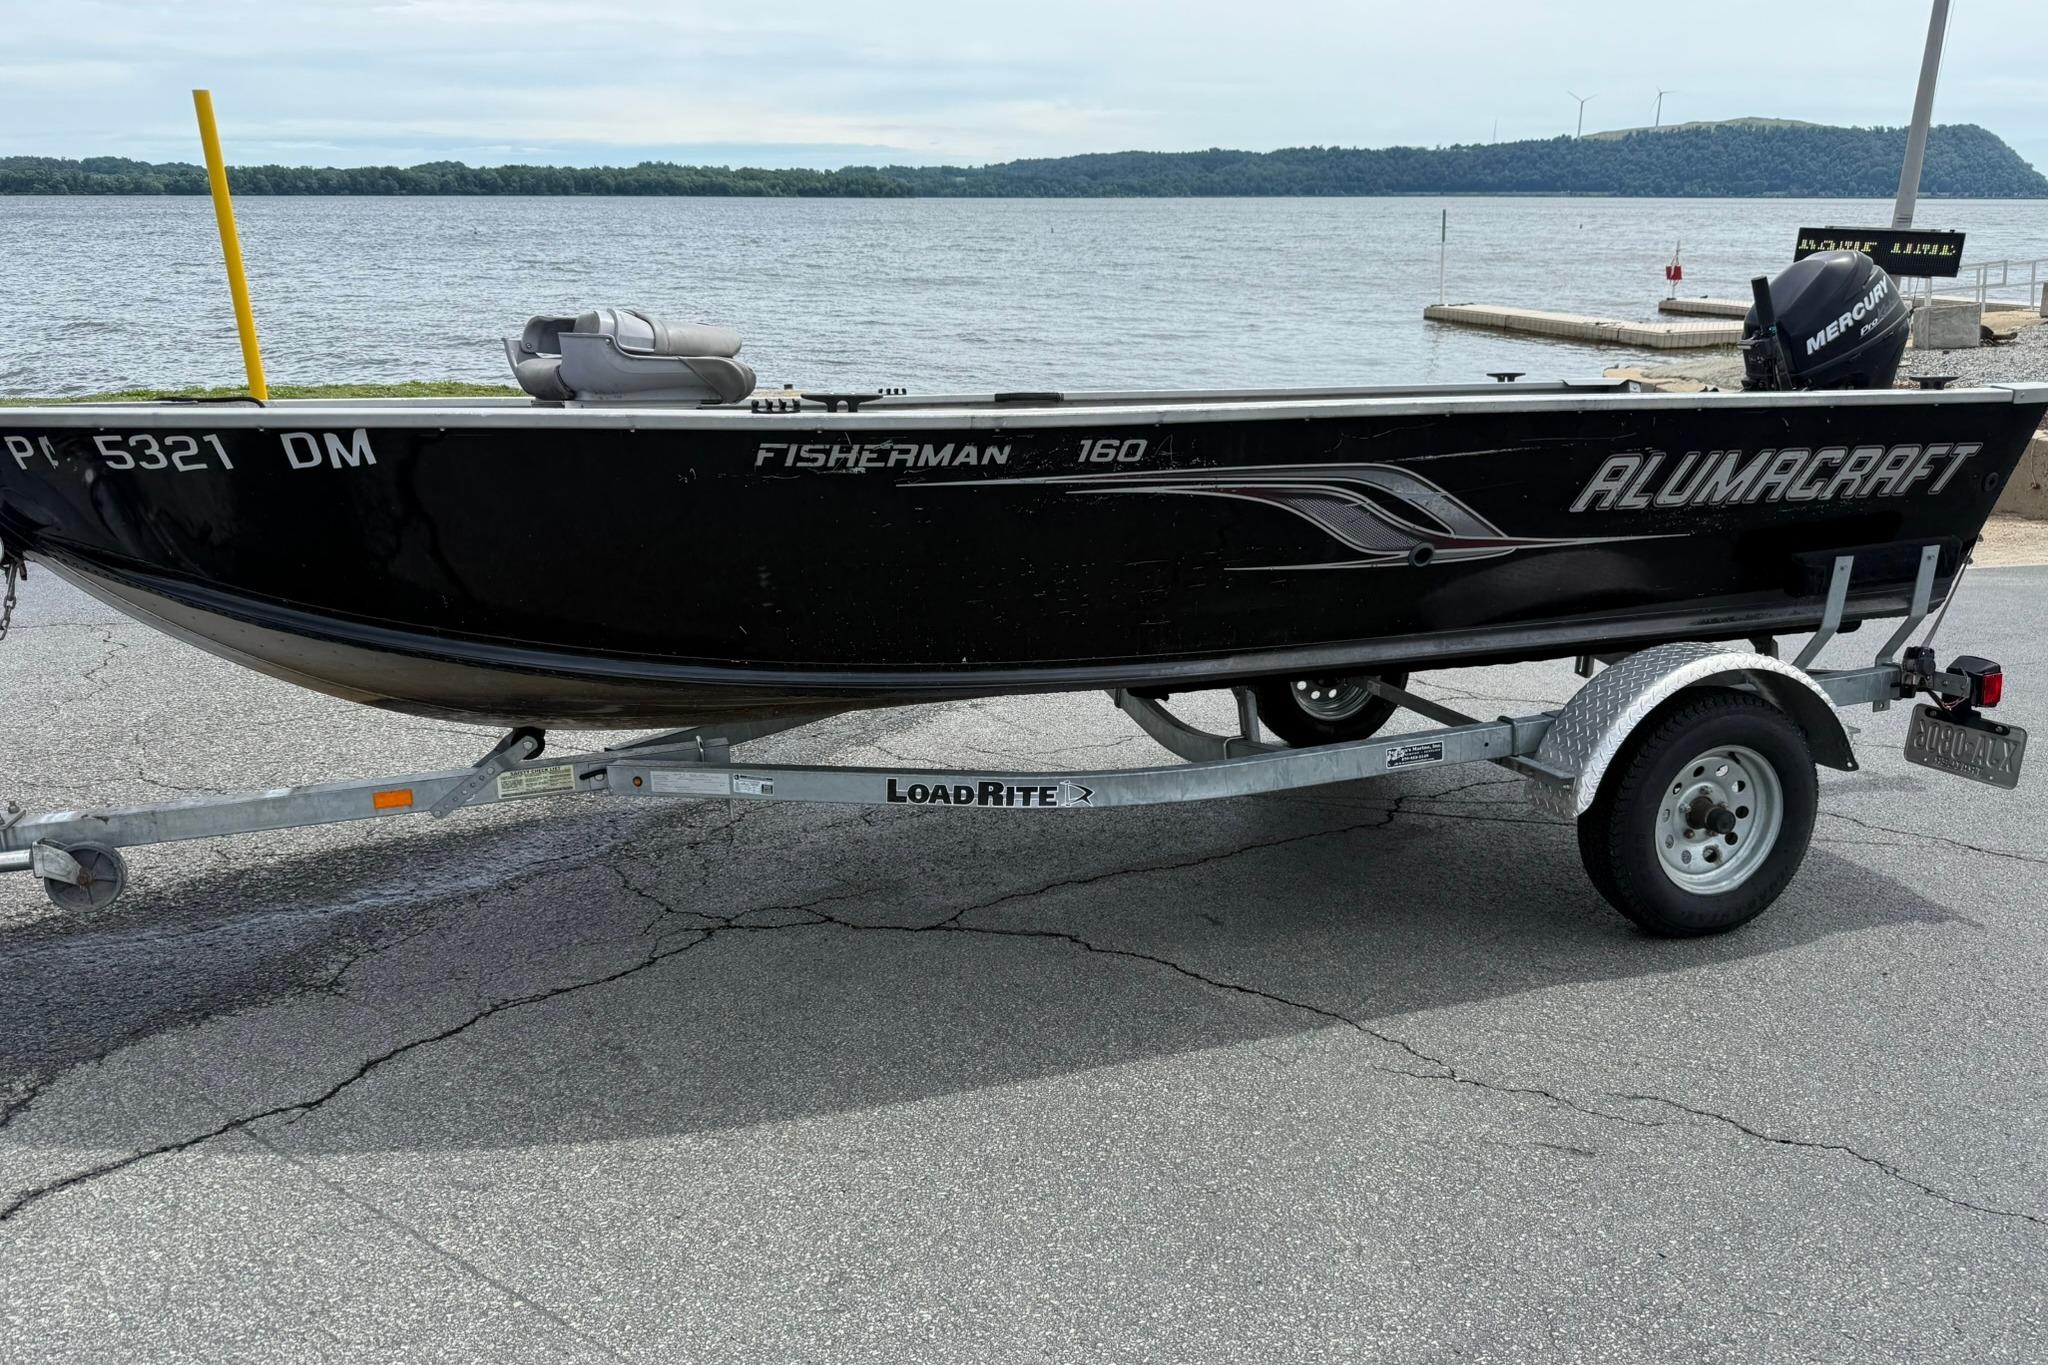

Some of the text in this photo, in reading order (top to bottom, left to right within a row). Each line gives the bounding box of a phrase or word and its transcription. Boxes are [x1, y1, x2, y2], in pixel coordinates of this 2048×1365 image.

[1805, 275, 1890, 356] MERCURY
[1859, 317, 1880, 338] Pro
[92, 433, 235, 472] 5321
[279, 428, 378, 470] DM
[754, 439, 1149, 469] FISHERMAN 160
[1568, 441, 1984, 513] ALUMACRAFT
